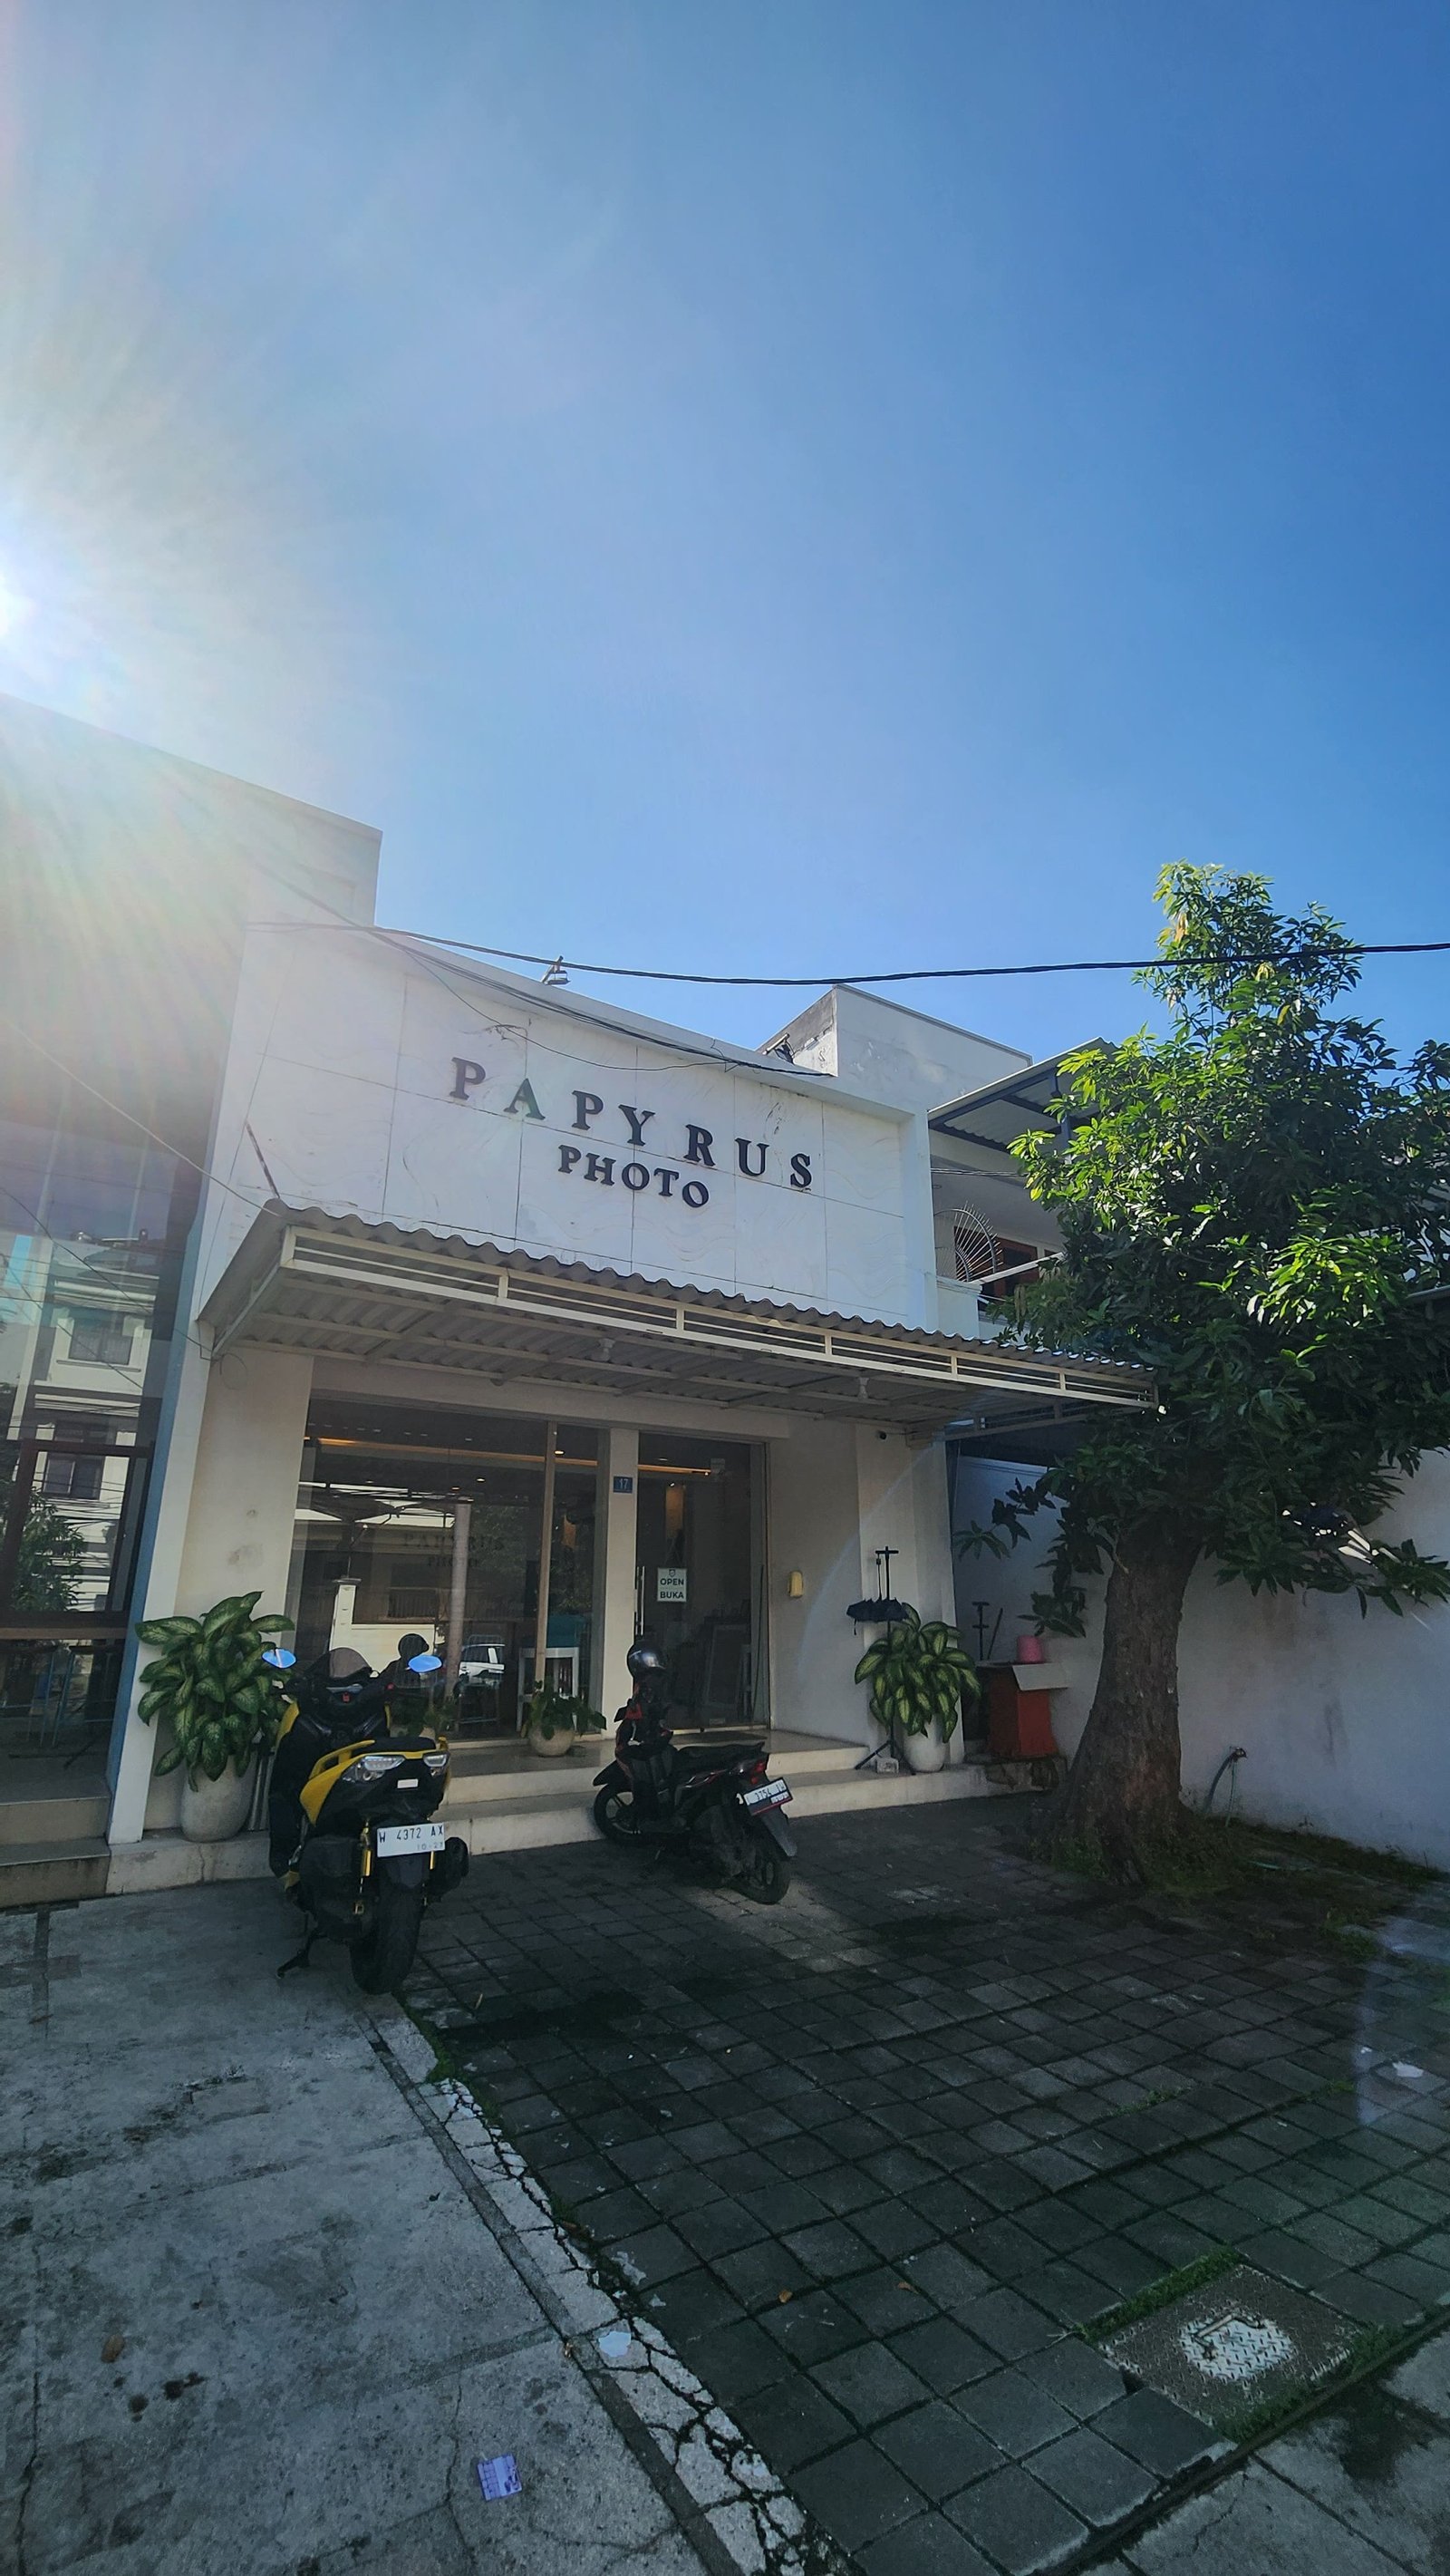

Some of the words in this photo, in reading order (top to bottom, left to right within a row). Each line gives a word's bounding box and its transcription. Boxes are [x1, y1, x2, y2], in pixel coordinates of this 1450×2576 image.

[449, 1056, 813, 1190] PAPYRUS
[558, 1144, 710, 1208] PHOTO
[619, 1478, 629, 1489] 17
[660, 1578, 684, 1586] OPEN
[379, 1832, 386, 1843] W
[396, 1827, 421, 1841] 4372
[430, 1825, 443, 1836] AX
